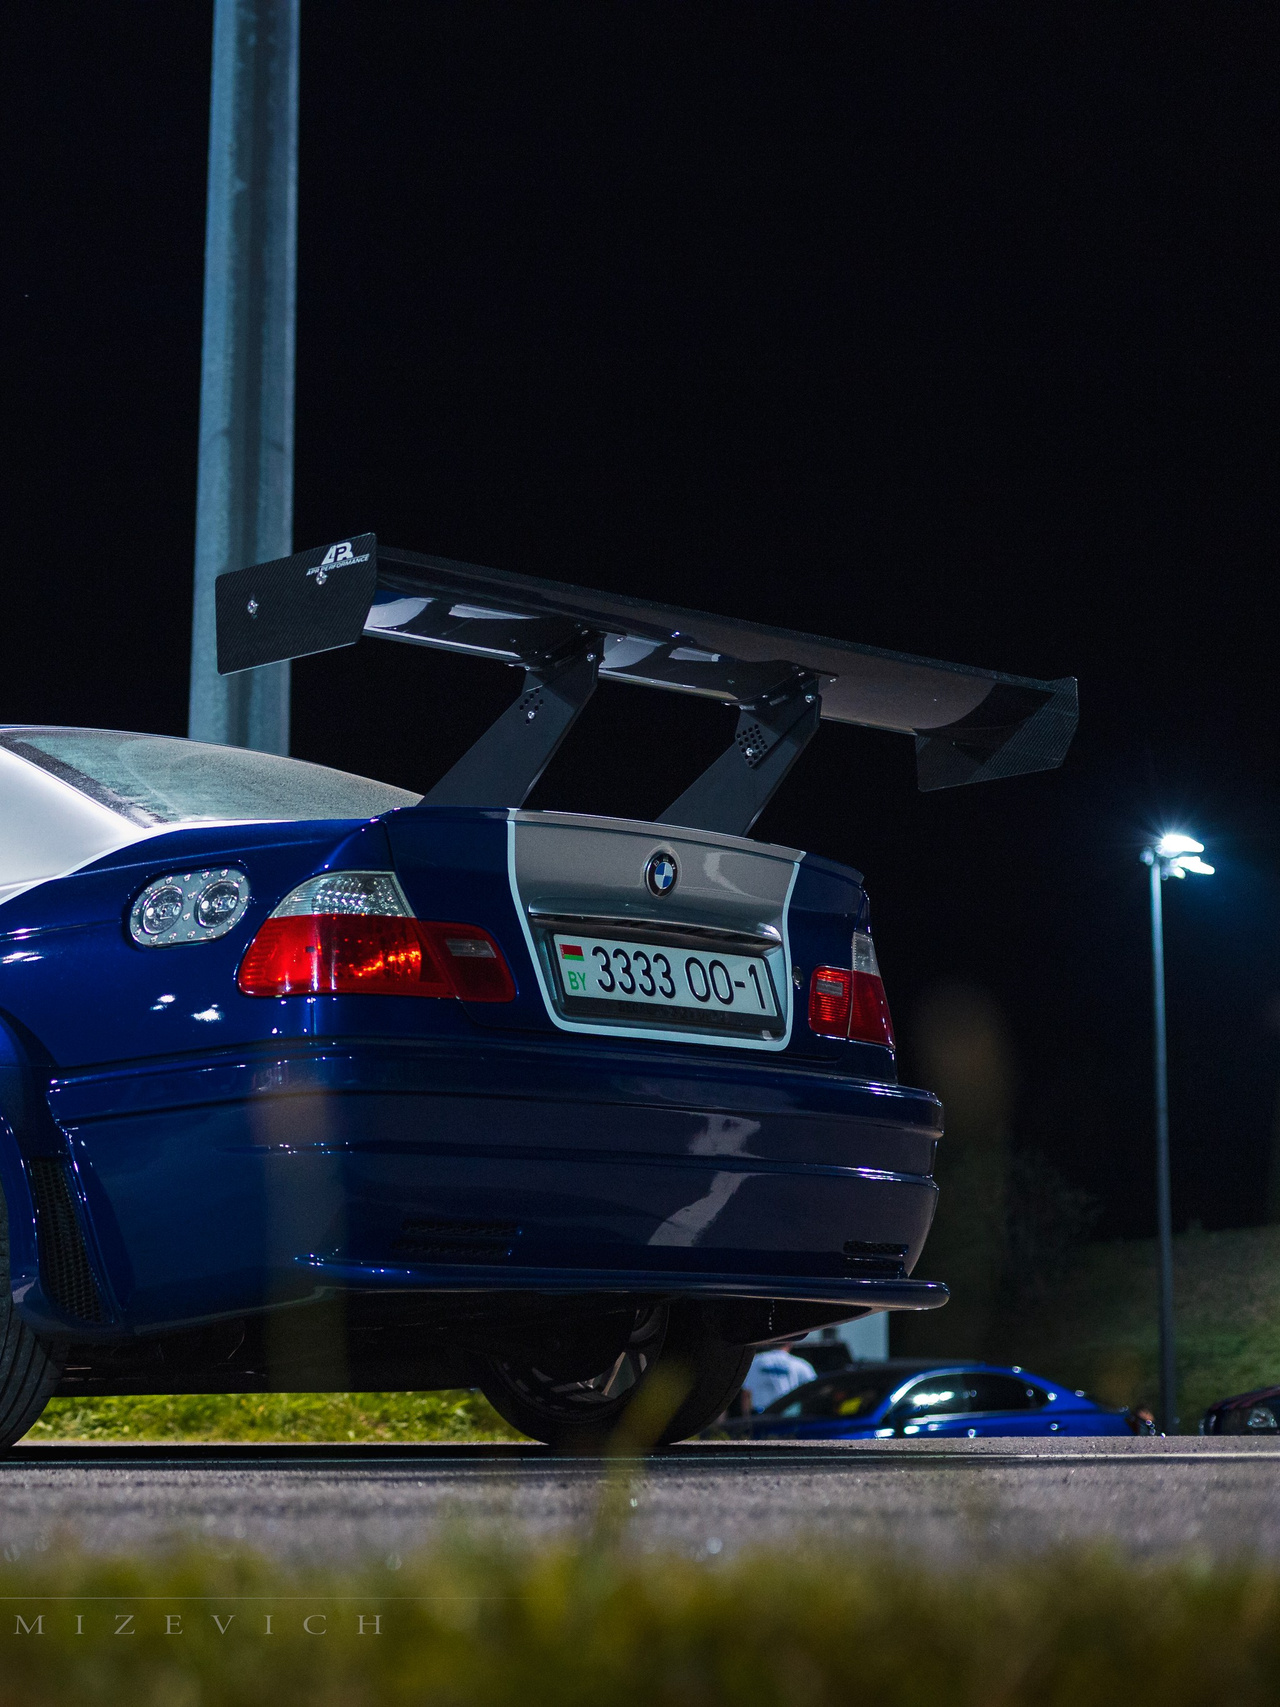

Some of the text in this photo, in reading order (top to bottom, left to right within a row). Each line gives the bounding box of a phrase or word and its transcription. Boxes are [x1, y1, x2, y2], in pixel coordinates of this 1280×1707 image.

[321, 553, 370, 571] PERFORMANCE
[567, 971, 586, 991] BY
[592, 946, 676, 999] 3333
